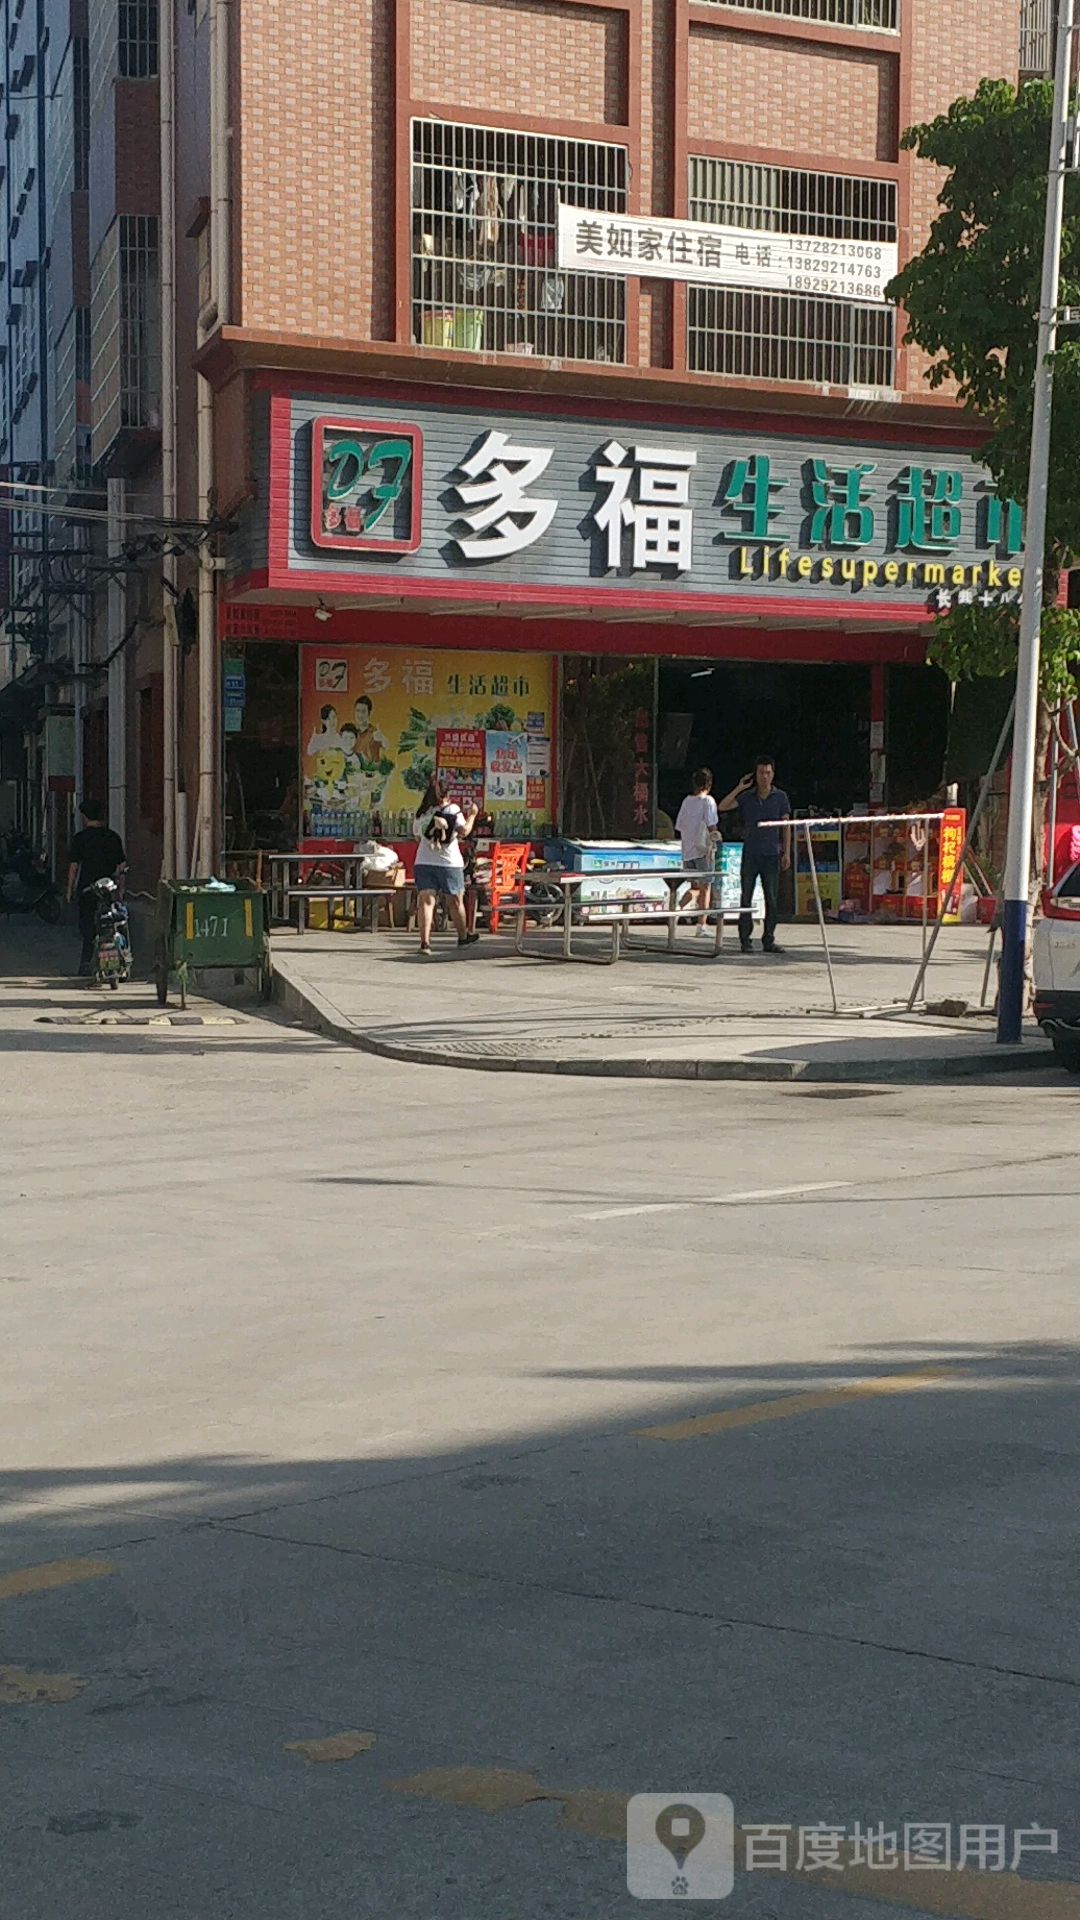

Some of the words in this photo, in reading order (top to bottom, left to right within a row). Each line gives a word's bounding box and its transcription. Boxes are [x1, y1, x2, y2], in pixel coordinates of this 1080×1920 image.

[575, 219, 723, 269] 美如家住宿
[788, 238, 882, 260] 13728213068
[787, 256, 882, 279] 13829214763
[786, 275, 882, 298] 18929213686
[455, 429, 698, 570] 多福
[740, 546, 1022, 588] Lifesupermarke
[363, 657, 435, 695] 多福
[447, 674, 530, 697] 生活超市
[195, 915, 229, 938] 1471
